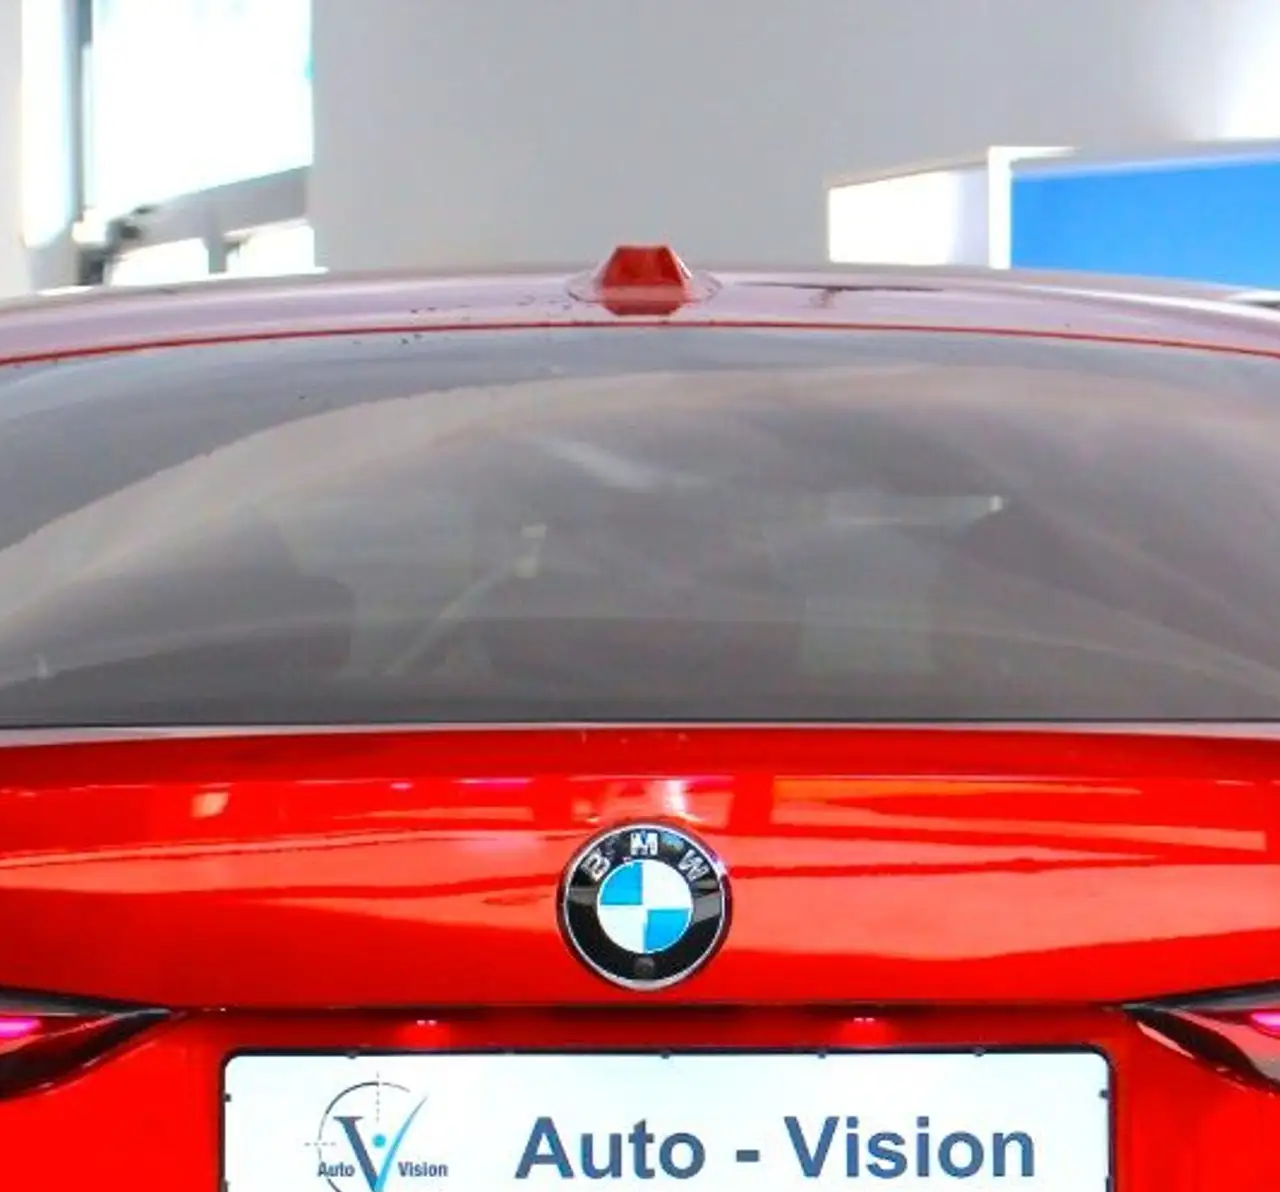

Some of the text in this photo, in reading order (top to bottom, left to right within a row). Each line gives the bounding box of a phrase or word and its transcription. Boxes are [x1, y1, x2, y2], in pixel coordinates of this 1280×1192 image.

[581, 832, 710, 882] BMW
[317, 1161, 449, 1178] Auto Vision
[514, 1115, 707, 1180] Auto
[783, 1115, 1036, 1180] Vision
